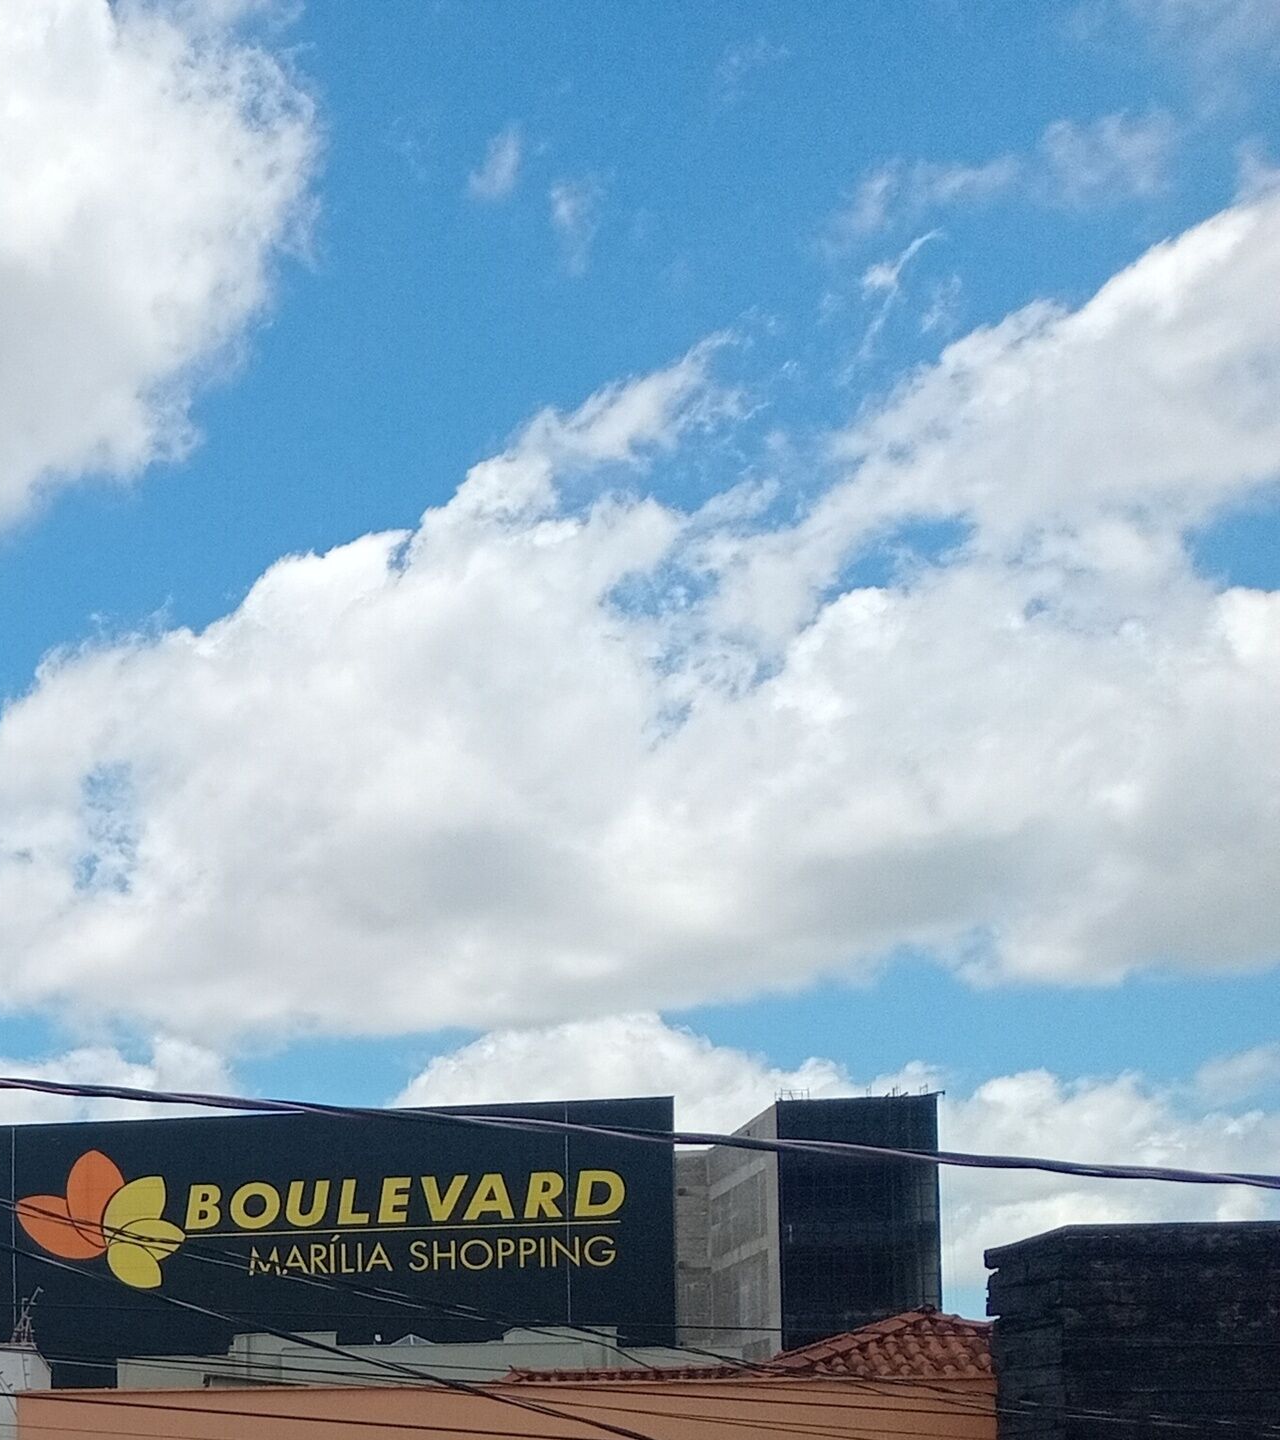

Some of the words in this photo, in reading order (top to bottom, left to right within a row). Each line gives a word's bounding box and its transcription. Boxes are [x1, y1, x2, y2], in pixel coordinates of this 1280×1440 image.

[184, 1169, 627, 1231] BOULEVARD
[248, 1234, 394, 1276] MARÍLIA
[408, 1235, 618, 1272] SHOPPING
